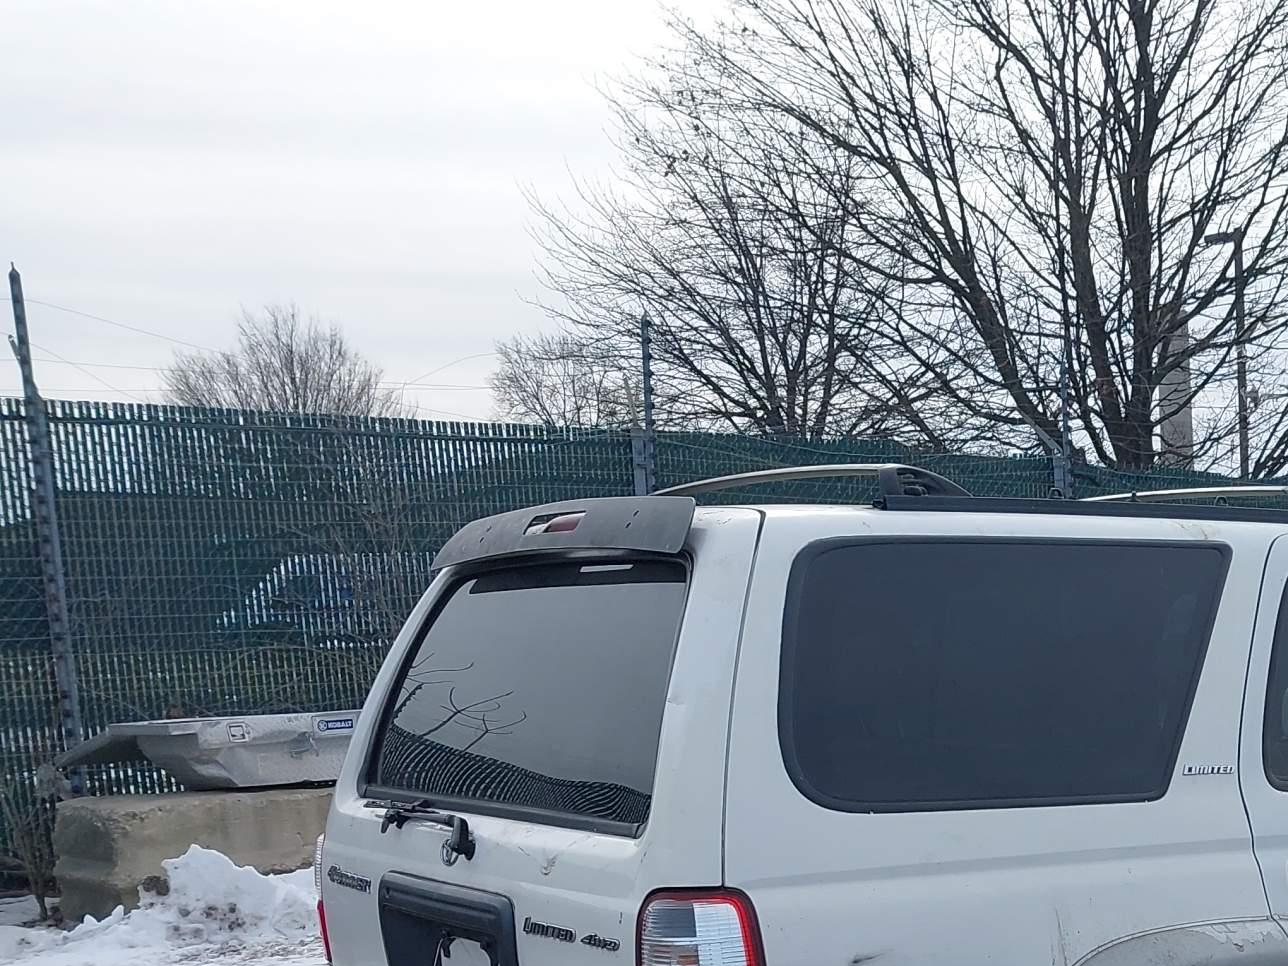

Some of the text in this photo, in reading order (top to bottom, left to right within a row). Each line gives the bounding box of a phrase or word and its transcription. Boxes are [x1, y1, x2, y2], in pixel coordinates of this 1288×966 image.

[1183, 764, 1234, 775] LIMITED
[523, 916, 621, 952] LIMITED 4WD
